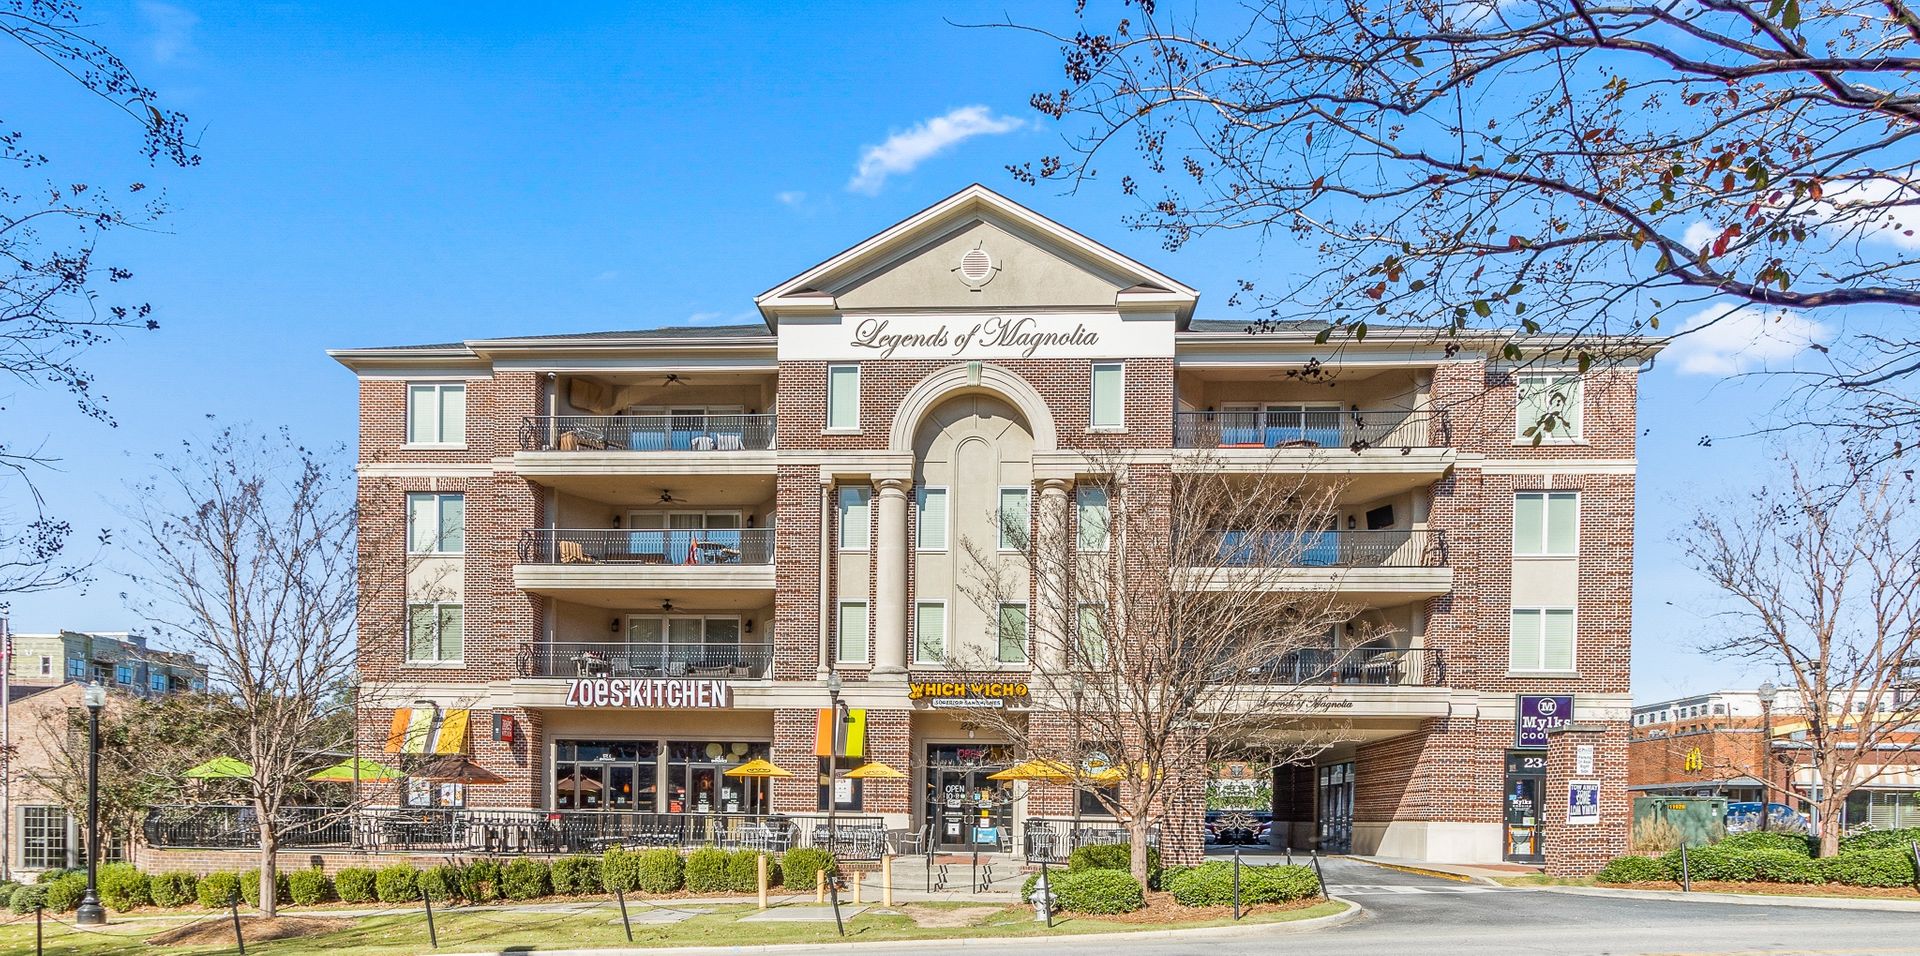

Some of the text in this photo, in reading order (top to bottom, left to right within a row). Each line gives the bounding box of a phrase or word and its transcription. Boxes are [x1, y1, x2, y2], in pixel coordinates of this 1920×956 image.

[851, 315, 1099, 359] Legends of Magnolia
[629, 679, 726, 708] KITCHEN
[908, 682, 967, 699] WHICH
[1306, 694, 1353, 712] Magnolia
[1540, 702, 1554, 711] M
[1522, 716, 1571, 731] Mylks
[945, 784, 965, 793] OPEN
